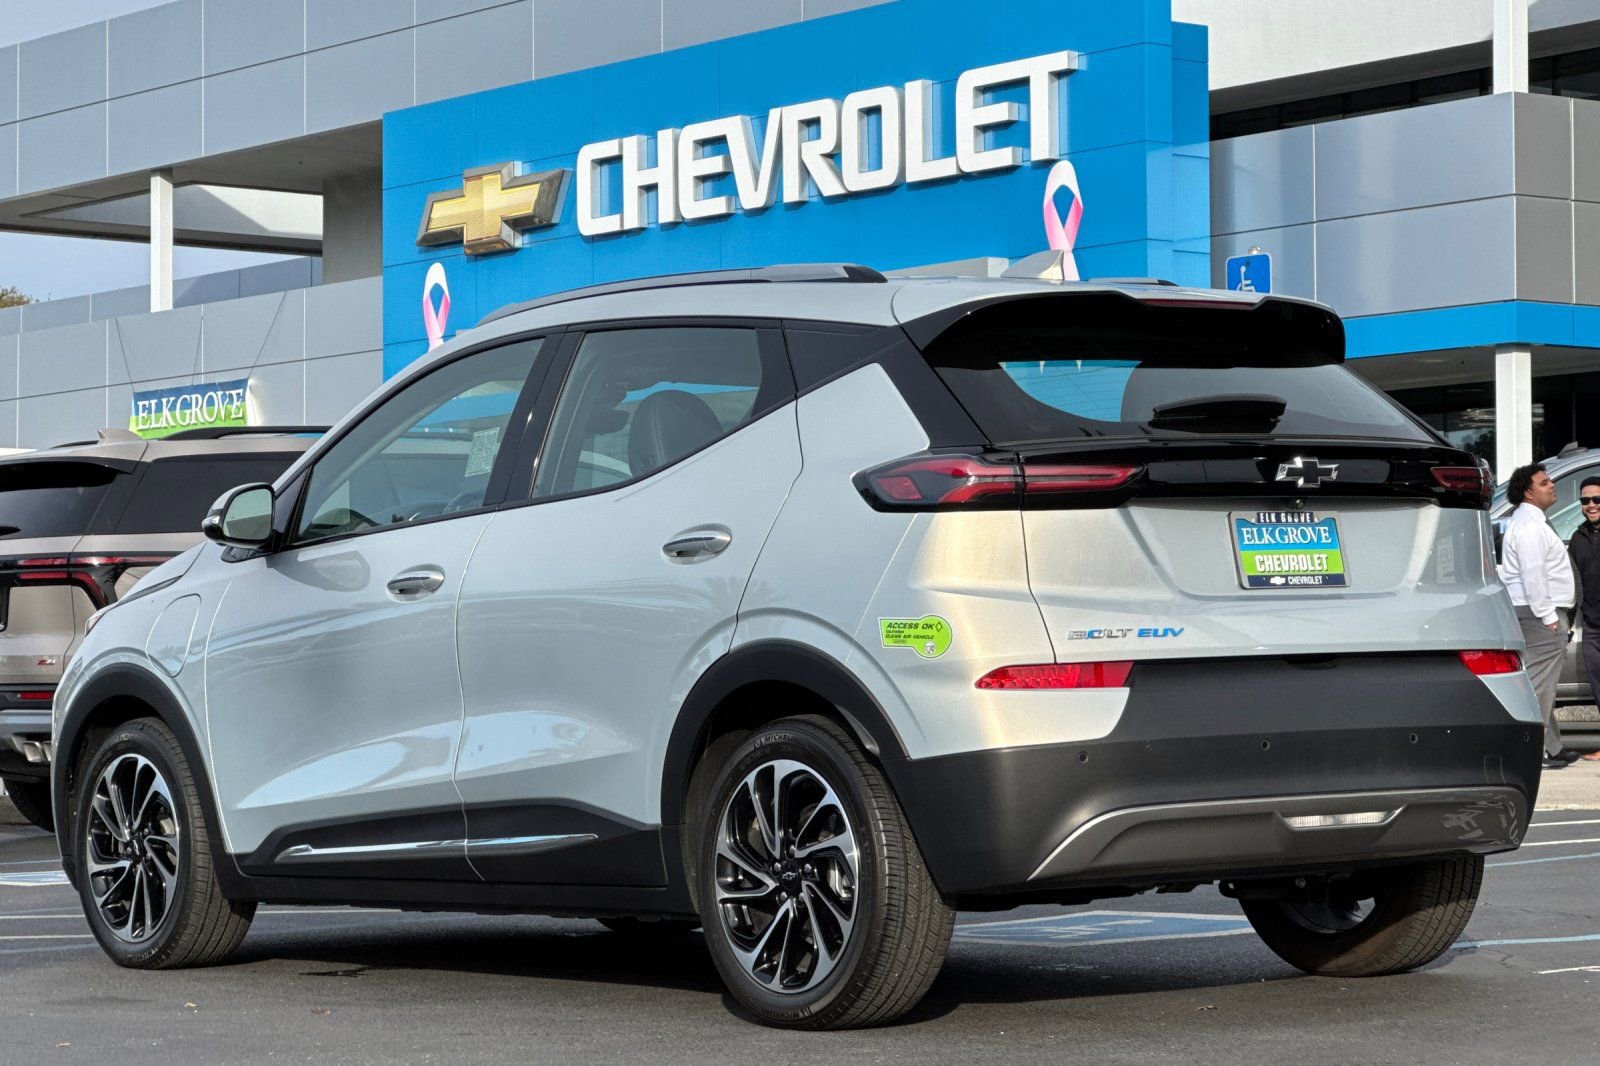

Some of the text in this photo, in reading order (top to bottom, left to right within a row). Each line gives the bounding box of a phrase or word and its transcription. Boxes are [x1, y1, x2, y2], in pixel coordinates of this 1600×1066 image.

[576, 50, 1077, 237] CHEVROLET
[1259, 512, 1311, 523] ELK GROVE
[1255, 553, 1328, 572] CHEVROLET
[1287, 575, 1323, 585] CHEVROLET
[886, 622, 919, 630] ACCESS
[1068, 627, 1185, 640] BOLT EUV
